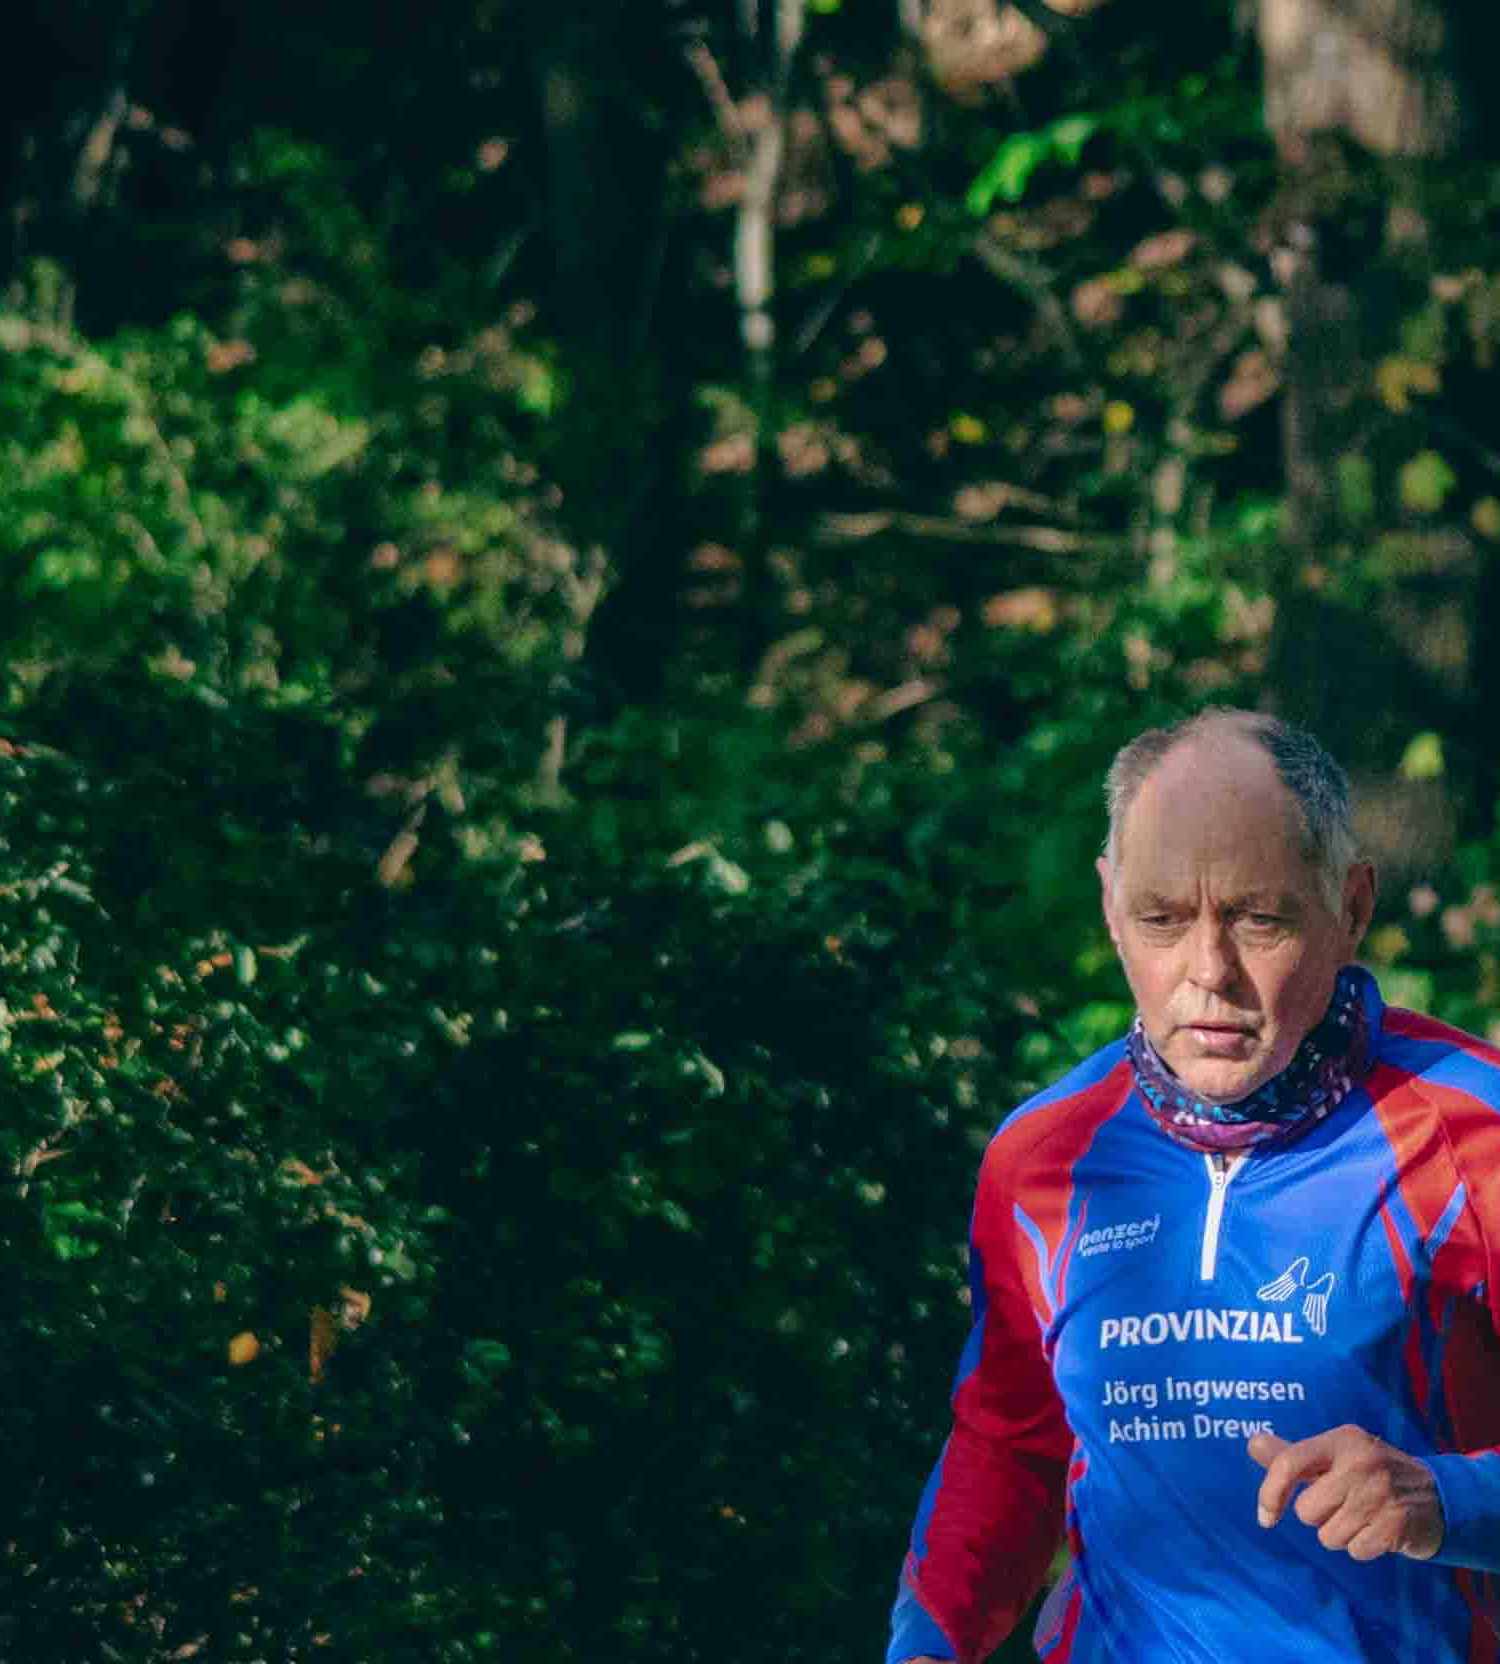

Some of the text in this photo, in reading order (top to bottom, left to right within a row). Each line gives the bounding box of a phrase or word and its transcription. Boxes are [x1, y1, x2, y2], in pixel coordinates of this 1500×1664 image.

[1100, 1309, 1303, 1349] PROVINZIAL
[1102, 1376, 1305, 1408] Jörg Ingwersen
[1109, 1413, 1275, 1443] Achim Drews
